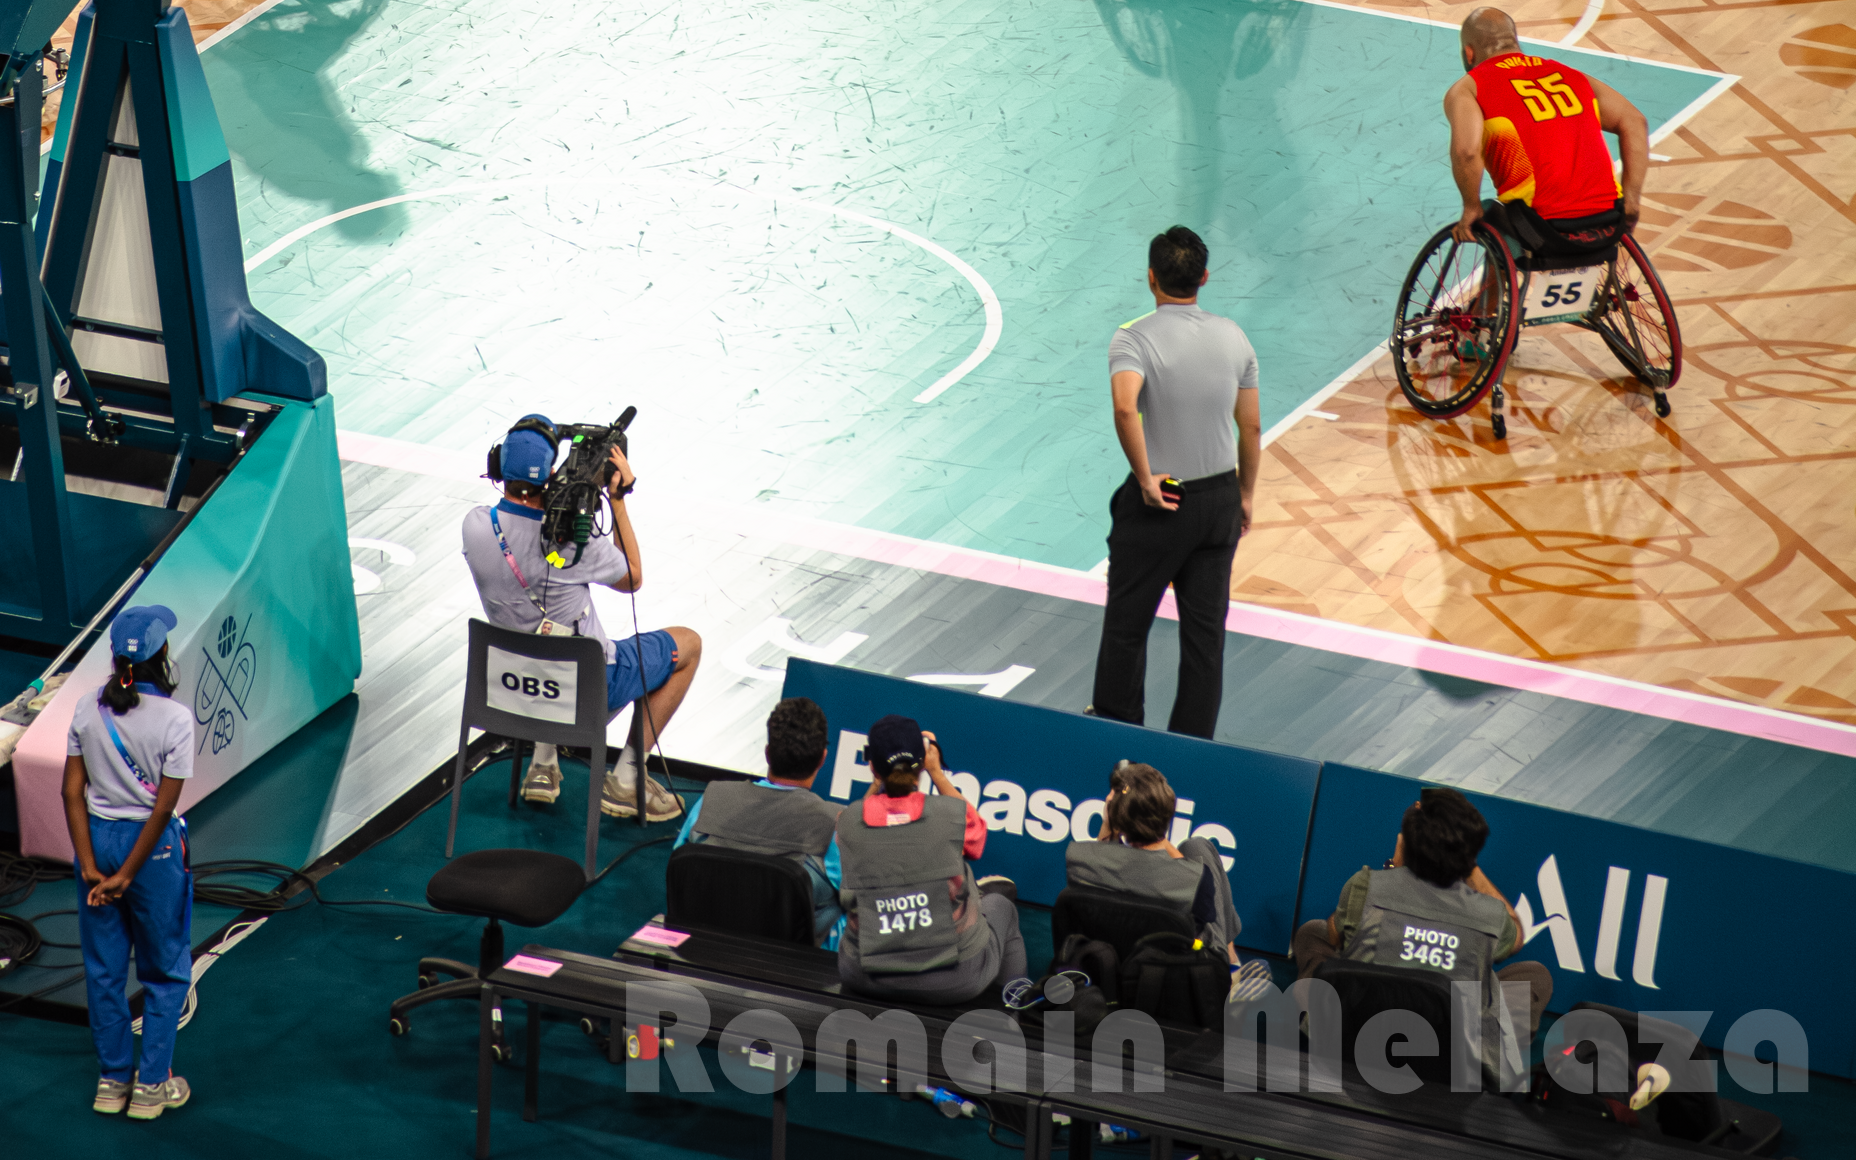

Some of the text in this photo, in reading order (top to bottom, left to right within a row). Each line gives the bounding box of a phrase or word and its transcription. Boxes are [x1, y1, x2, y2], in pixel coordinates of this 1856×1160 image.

[1508, 71, 1584, 123] 55
[1540, 281, 1582, 308] 55
[501, 671, 560, 700] OBS
[875, 893, 929, 913] PHOTO
[879, 908, 933, 934] 1478
[1404, 926, 1459, 949] PHOTO
[1399, 940, 1457, 971] 3463
